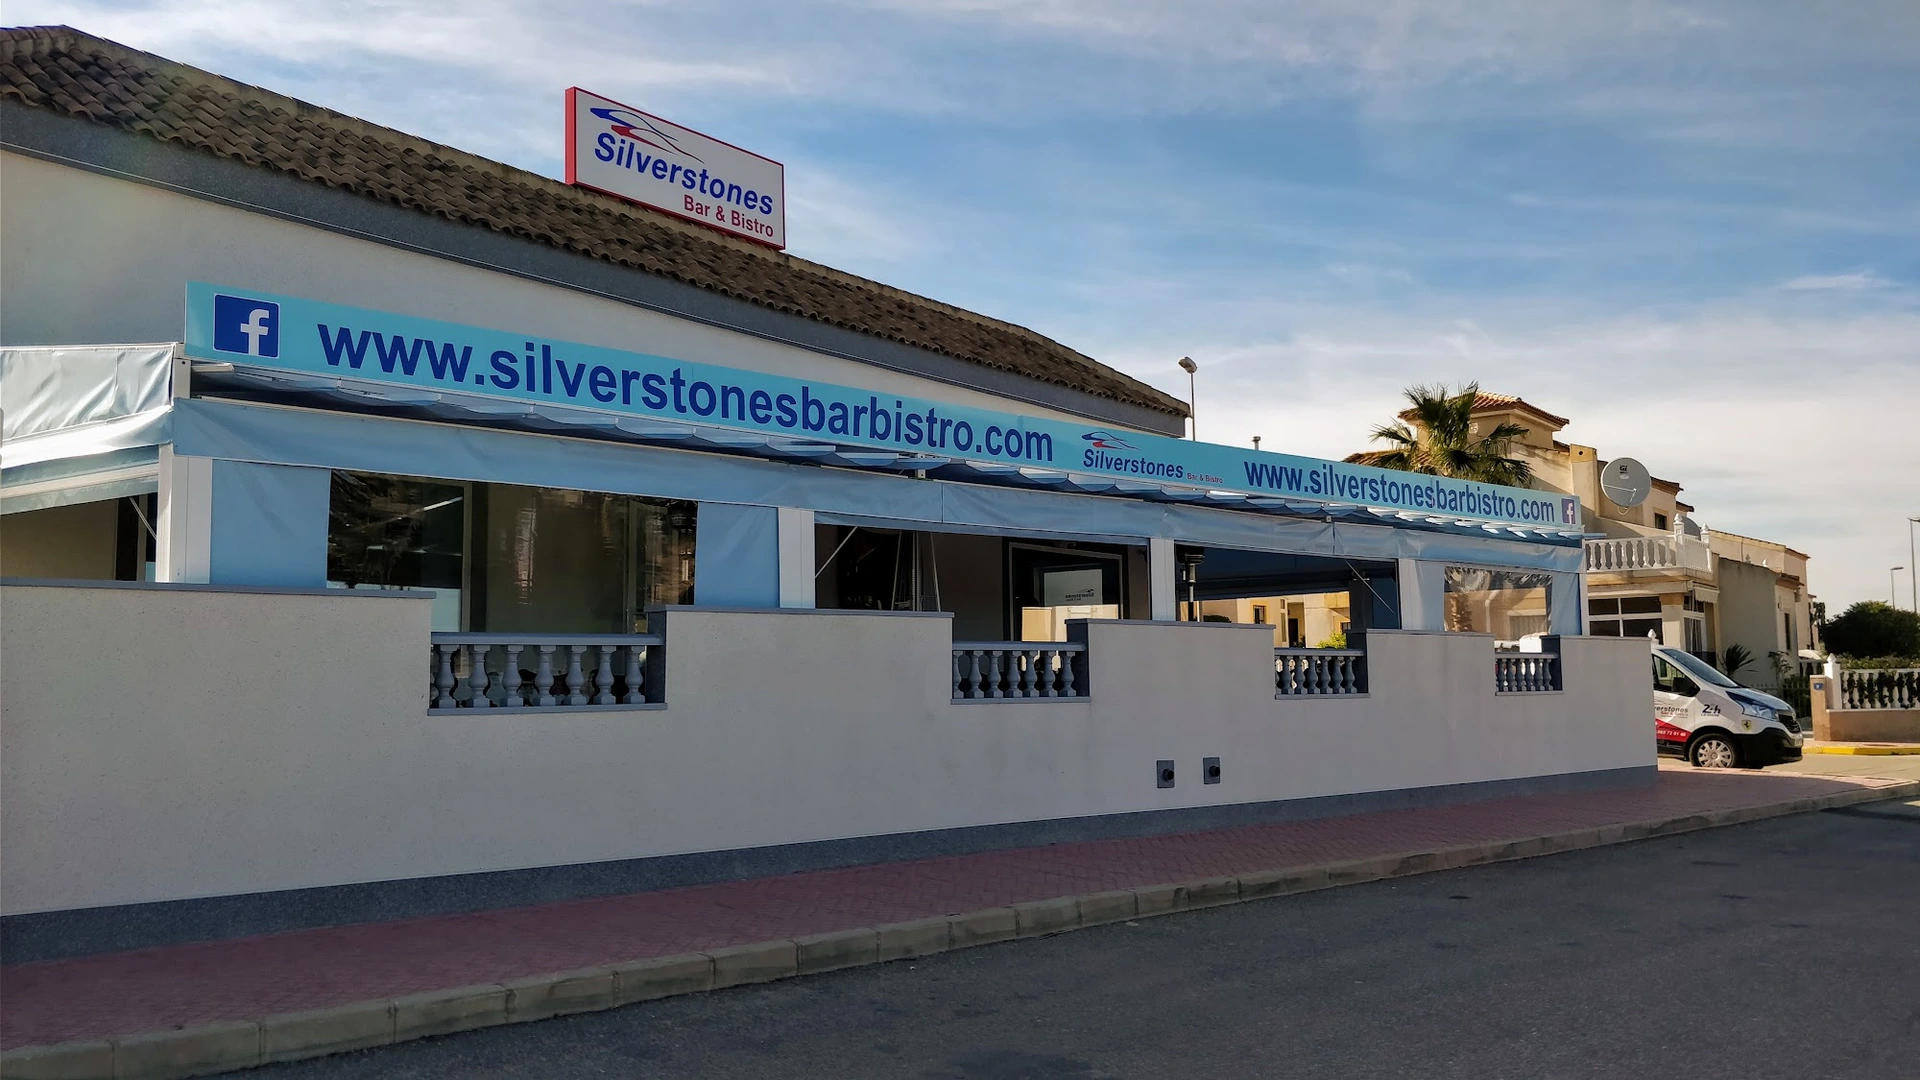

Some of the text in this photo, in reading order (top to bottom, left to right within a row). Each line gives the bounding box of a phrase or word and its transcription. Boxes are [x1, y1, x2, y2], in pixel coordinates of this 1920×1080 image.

[594, 132, 773, 215] Silverstones
[683, 194, 774, 237] Bar & Bistro
[317, 323, 1053, 462] www.silverstonesbarbistro.com
[1083, 449, 1184, 478] Silverstones
[1187, 472, 1198, 480] Bar
[1206, 474, 1224, 484] Bistro
[1244, 461, 1555, 523] www.silverstonesbarbistro.com
